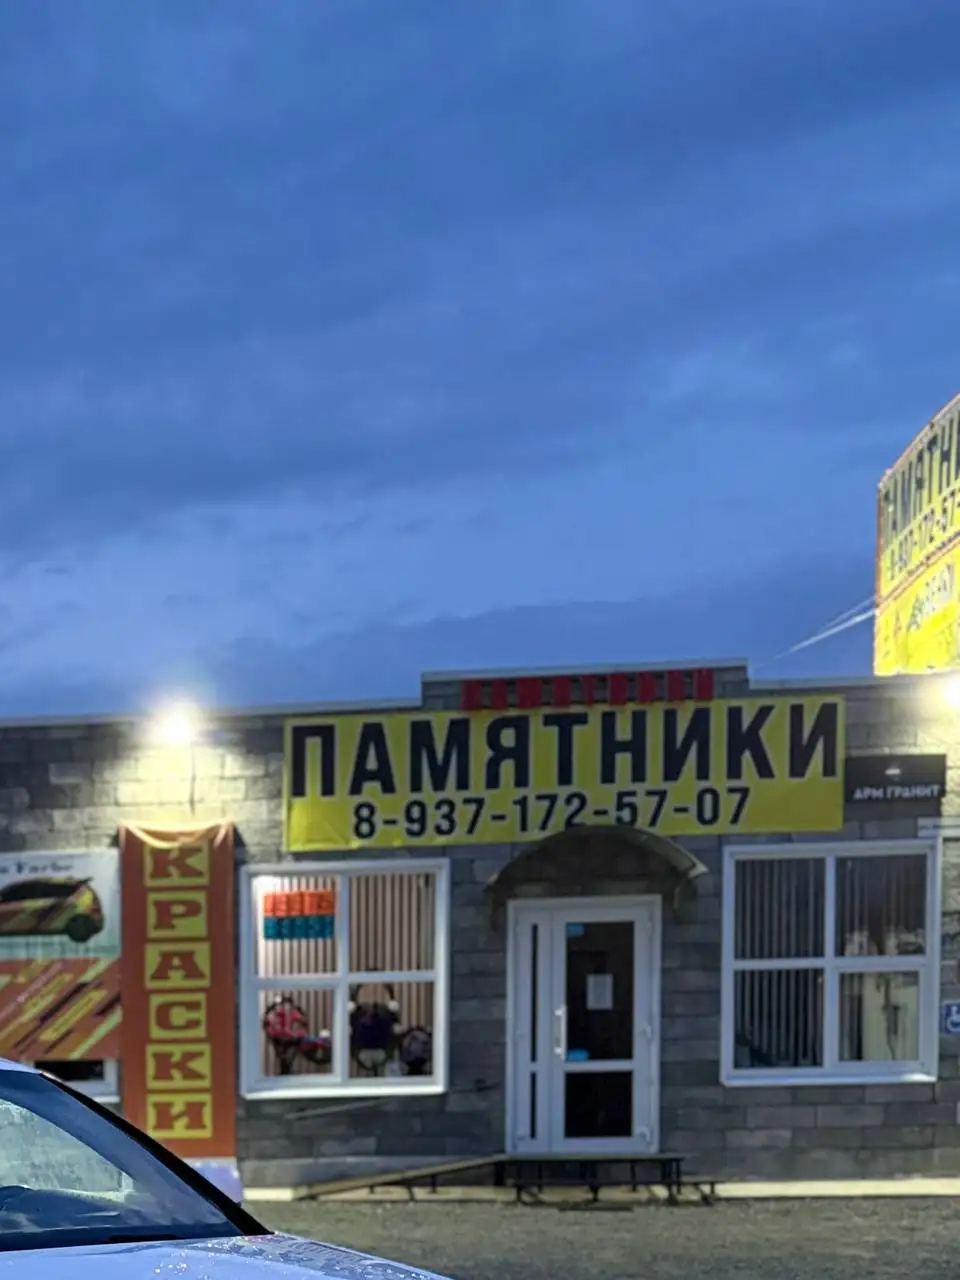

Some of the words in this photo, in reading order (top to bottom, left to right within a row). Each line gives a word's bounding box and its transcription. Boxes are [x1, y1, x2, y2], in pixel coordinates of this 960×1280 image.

[291, 702, 838, 797] ПАМЯТНИКИ
[354, 786, 750, 839] 8-937-172-57-07
[886, 784, 940, 799] ГРАНИТ
[148, 843, 209, 1132] КРАСКИ
